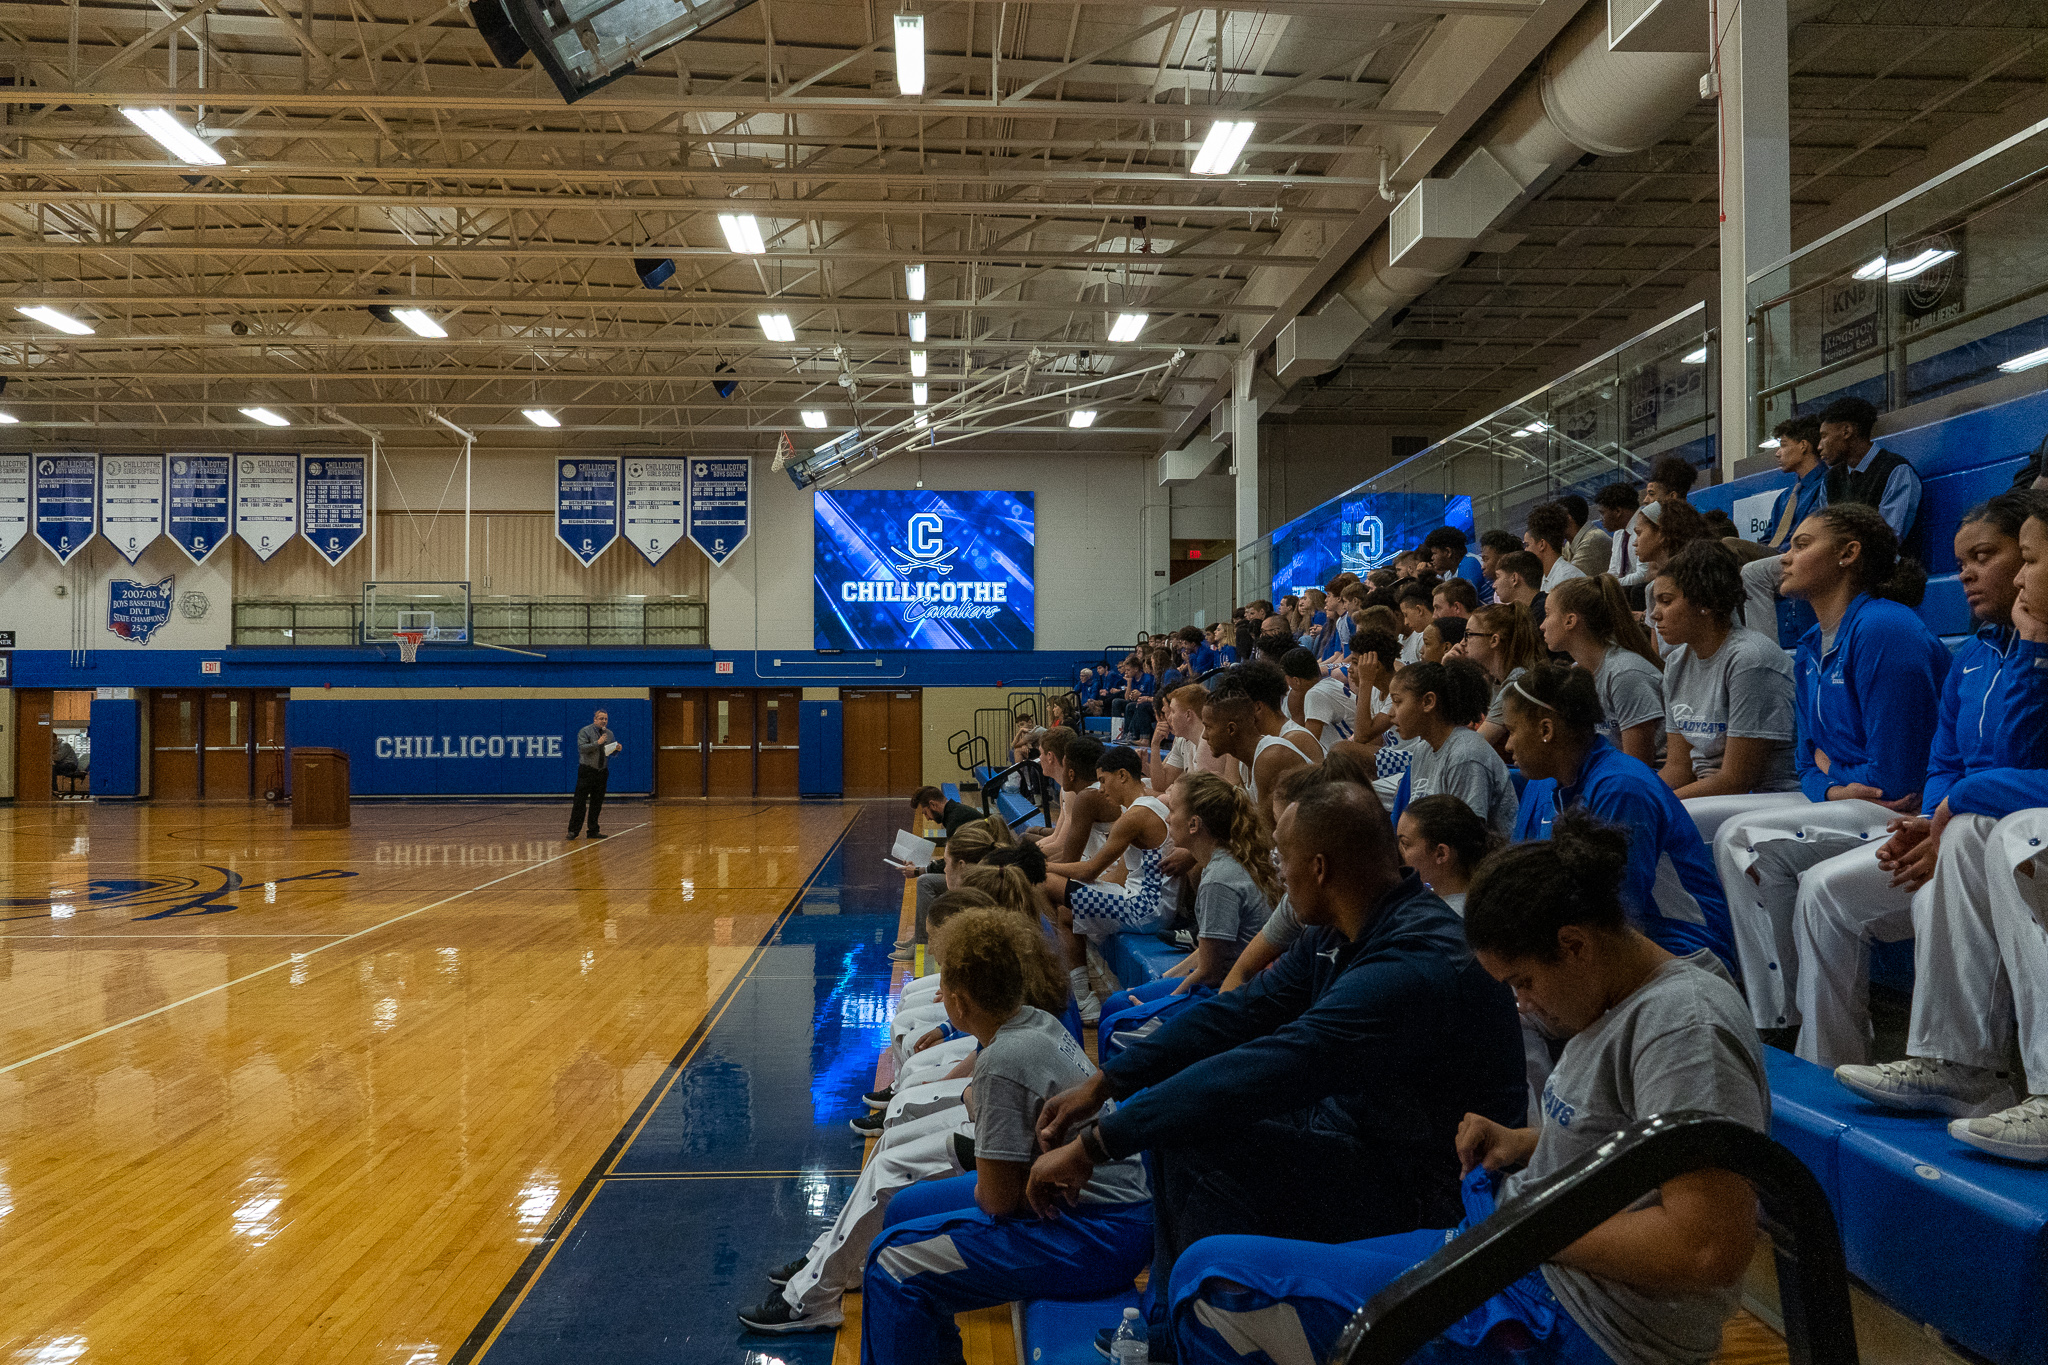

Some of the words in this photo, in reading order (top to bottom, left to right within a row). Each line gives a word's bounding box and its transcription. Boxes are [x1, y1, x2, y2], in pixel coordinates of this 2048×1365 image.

[1824, 321, 1874, 350] KINGSTON
[1824, 343, 1854, 362] National
[1856, 335, 1873, 350] Bank
[908, 512, 943, 558] C
[61, 536, 68, 548] C
[129, 537, 136, 548] C
[194, 536, 204, 548] C
[261, 536, 269, 547] C
[330, 537, 339, 549] C
[583, 539, 592, 550] C
[650, 538, 659, 549] C
[715, 538, 724, 550] C
[122, 590, 157, 598] 2007-08
[841, 580, 1007, 602] CHILLICOTHE
[113, 600, 128, 609] BOYS
[129, 600, 166, 609] BASKETBALL
[903, 596, 1001, 623] Cavaliers
[113, 613, 130, 622] STATE
[131, 613, 165, 622] CHAMPIONS
[205, 662, 217, 672] EXIT
[719, 662, 730, 672] EXIT
[375, 735, 563, 759] CHILLICOTHE
